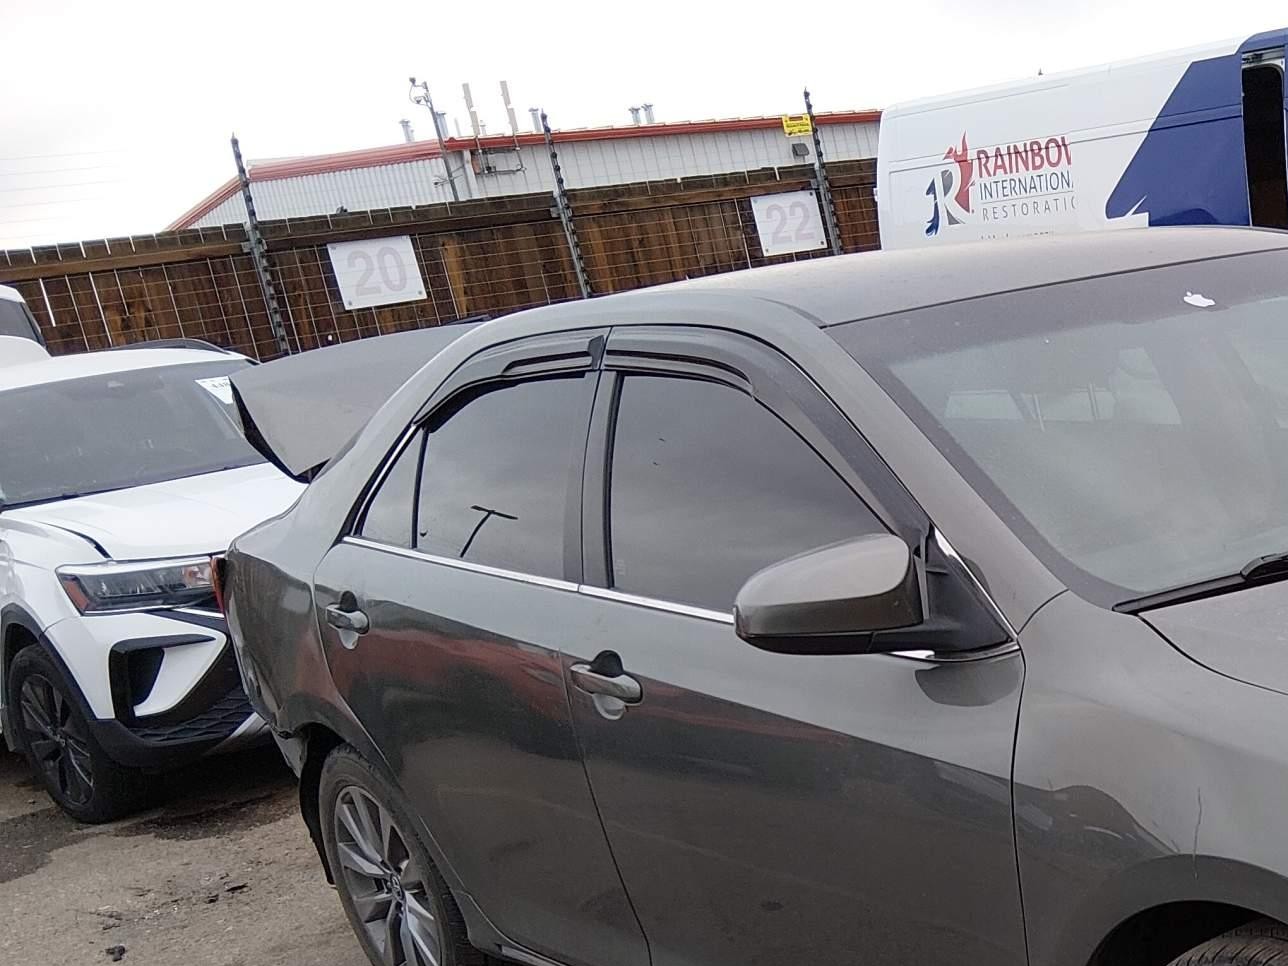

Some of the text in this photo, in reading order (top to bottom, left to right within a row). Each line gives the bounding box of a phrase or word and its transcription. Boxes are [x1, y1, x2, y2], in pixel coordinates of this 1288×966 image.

[979, 170, 1074, 200] INTERNATION
[766, 201, 816, 245] 22
[347, 247, 407, 296] 20
